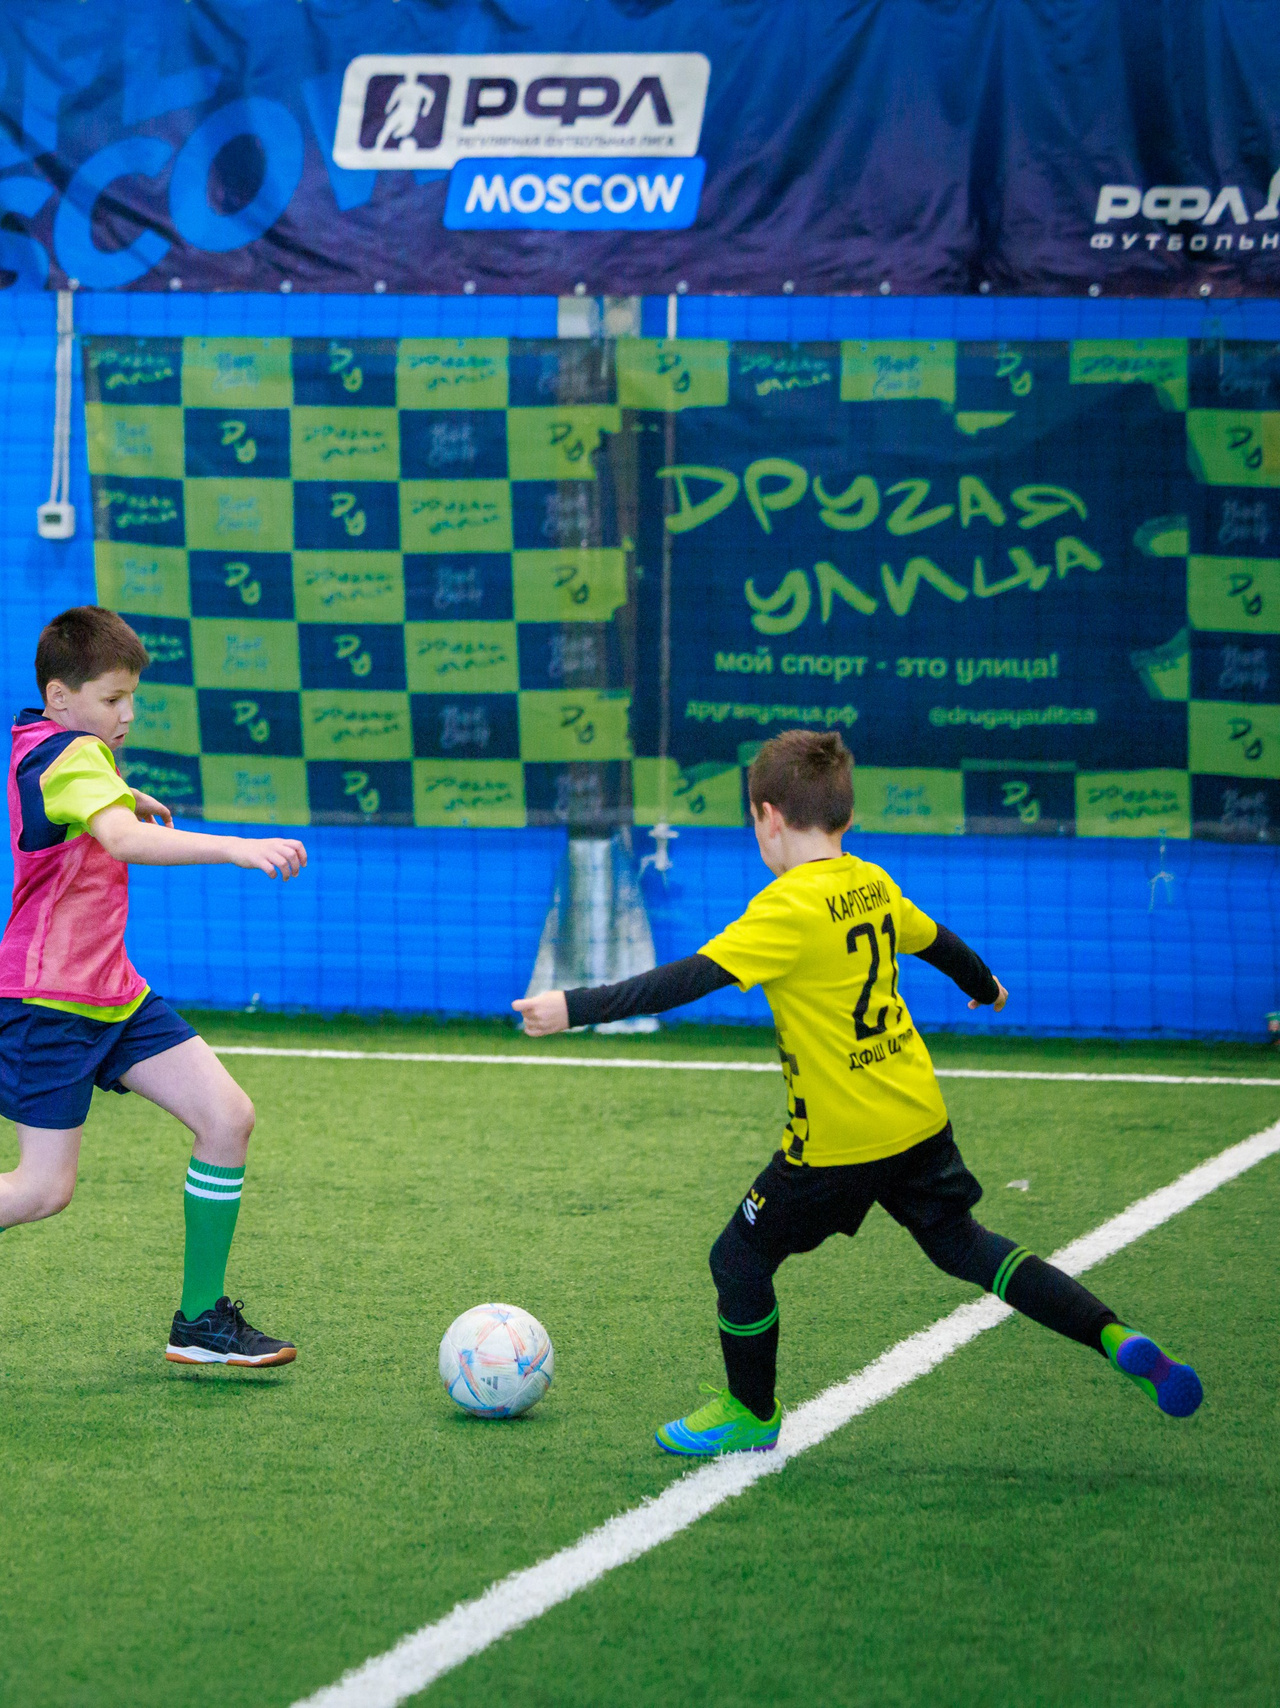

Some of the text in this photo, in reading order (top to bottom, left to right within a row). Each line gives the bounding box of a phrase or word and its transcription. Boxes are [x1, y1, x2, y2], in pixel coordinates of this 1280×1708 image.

[461, 75, 675, 126] РФЛ
[465, 173, 684, 214] MOSCOW
[1095, 184, 1249, 225] РФЛ
[655, 457, 1088, 535] ДРУГАЯ
[745, 535, 1104, 635] УЛИЦА
[781, 654, 868, 684] спорт
[895, 656, 948, 679] это
[956, 653, 1058, 686] улица!
[825, 880, 891, 923] КАРПЕНКО
[847, 912, 903, 1041] 21
[849, 1042, 886, 1071] ДФШ
